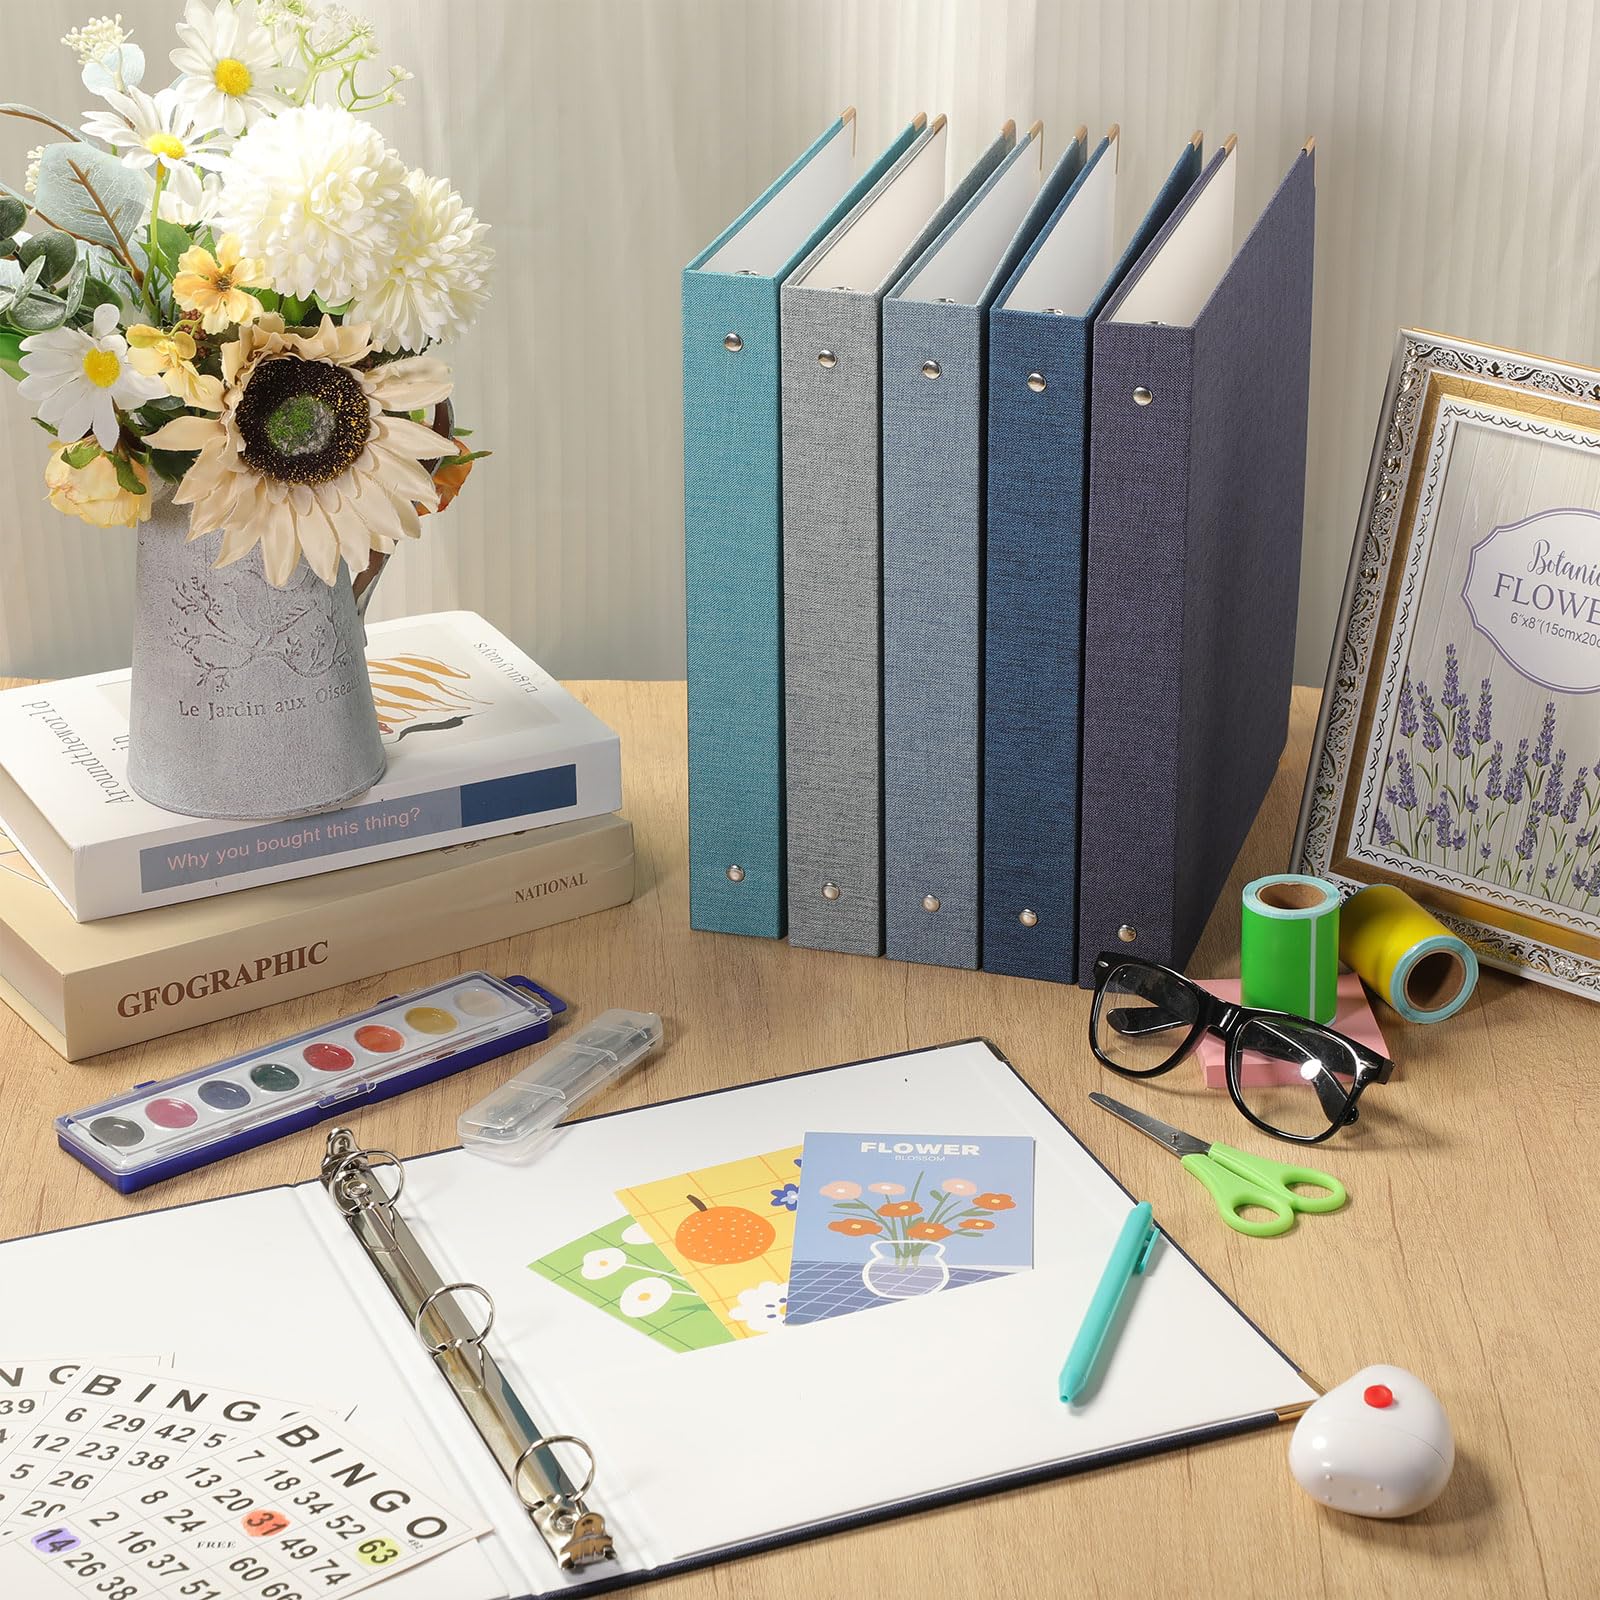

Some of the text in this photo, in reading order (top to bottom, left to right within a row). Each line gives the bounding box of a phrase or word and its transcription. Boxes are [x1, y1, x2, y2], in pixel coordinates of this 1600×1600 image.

[178, 700, 200, 717] Le
[275, 696, 307, 713] aux
[167, 806, 421, 872] Why you bought this thing?
[514, 872, 588, 904] NATIONAL
[860, 1141, 981, 1156] FLOWER
[894, 1154, 946, 1162] BLOSSOM
[81, 1374, 301, 1423] BING
[66, 1408, 237, 1448] 6 29 42 5
[33, 1435, 169, 1469] 12 23 38
[11, 1464, 93, 1489] 5 26
[186, 1468, 350, 1585] 13 20 31 49 74
[238, 1450, 264, 1462] 7
[265, 1470, 300, 1490] 18
[294, 1492, 333, 1514] 34
[326, 1515, 365, 1539] 52
[359, 1540, 398, 1563] 63
[90, 1512, 119, 1526] 2
[119, 1532, 156, 1553] 16
[148, 1555, 189, 1575] 37
[141, 1491, 168, 1504] 8
[165, 1509, 205, 1532] 24
[230, 1558, 269, 1580] 60
[36, 1529, 137, 1600] 14 26 38
